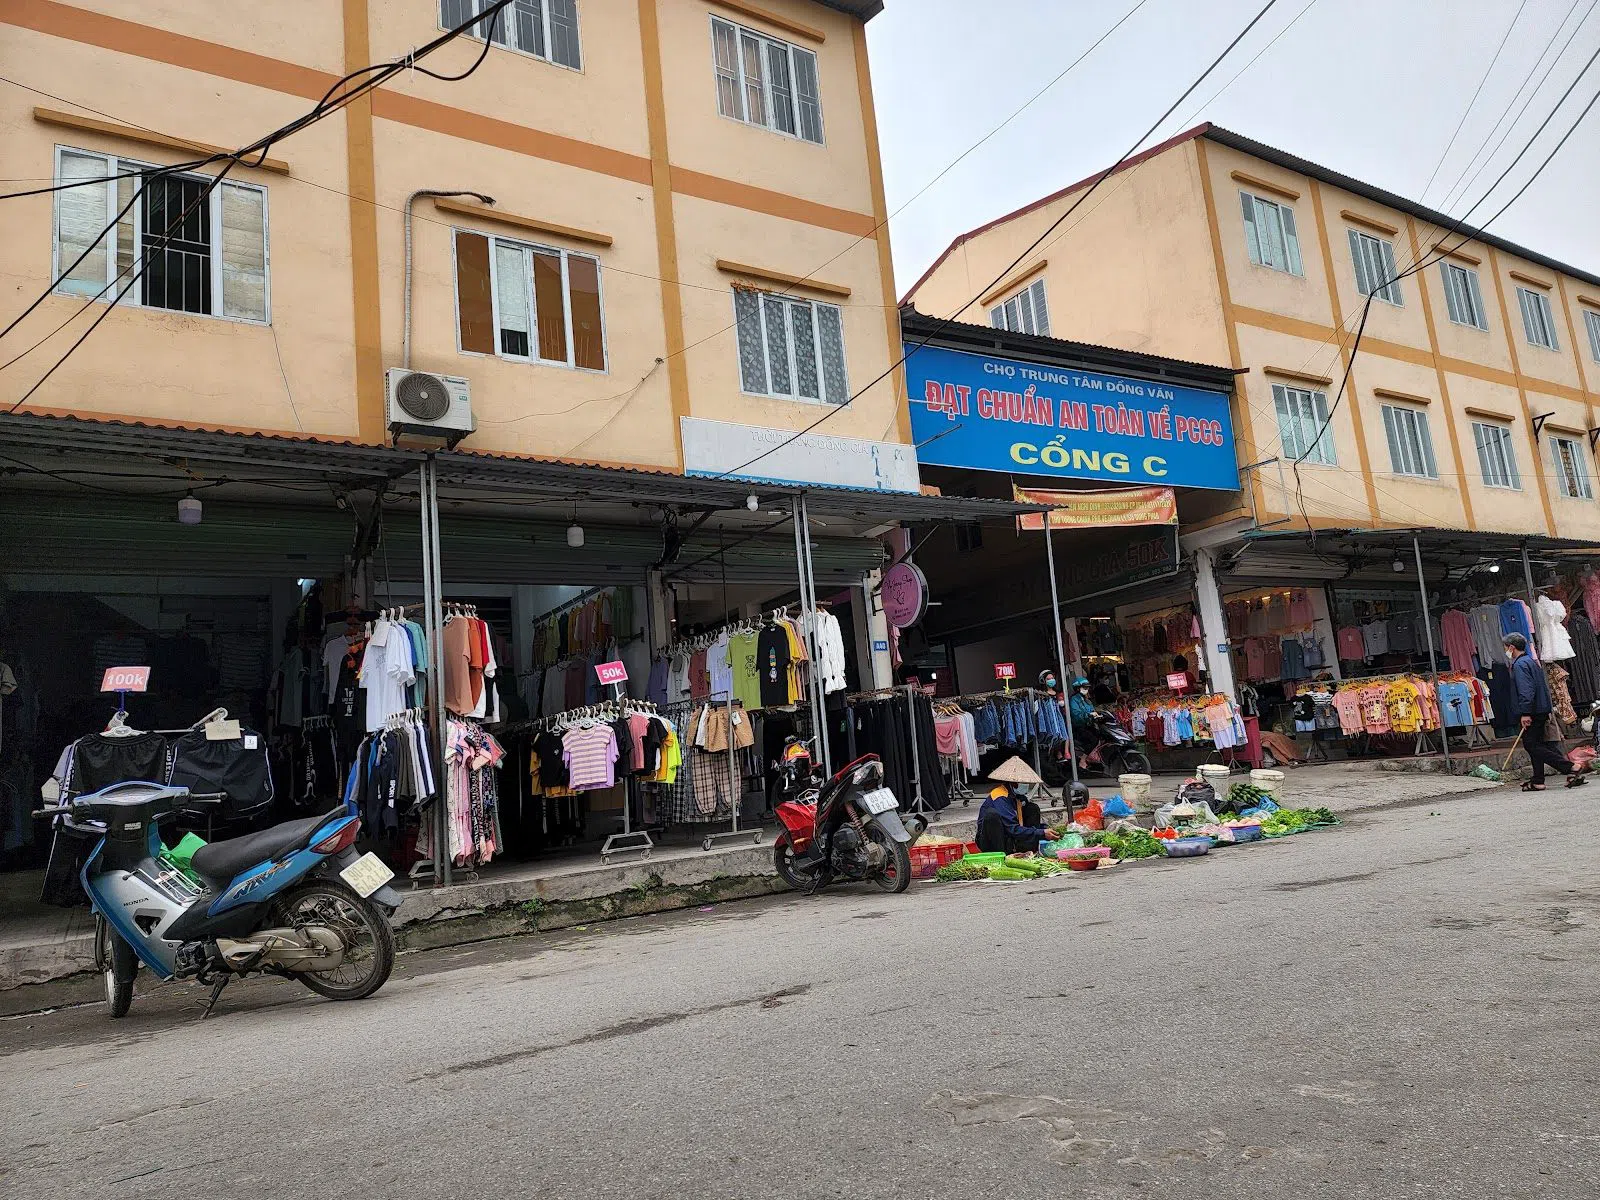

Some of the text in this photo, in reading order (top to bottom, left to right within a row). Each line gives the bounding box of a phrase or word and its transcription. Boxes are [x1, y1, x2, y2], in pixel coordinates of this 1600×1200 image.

[984, 362, 1174, 401] CHỢ TRUNG TÂM ĐỒNG VĂN
[924, 380, 1224, 447] ĐẠT CHUẨN AN TOÀN VỀ PCCC
[1009, 434, 1168, 477] CỔNG C
[602, 667, 623, 679] 50k
[997, 665, 1014, 676] 70K
[107, 673, 144, 685] 100k
[123, 897, 149, 907] HONDA
